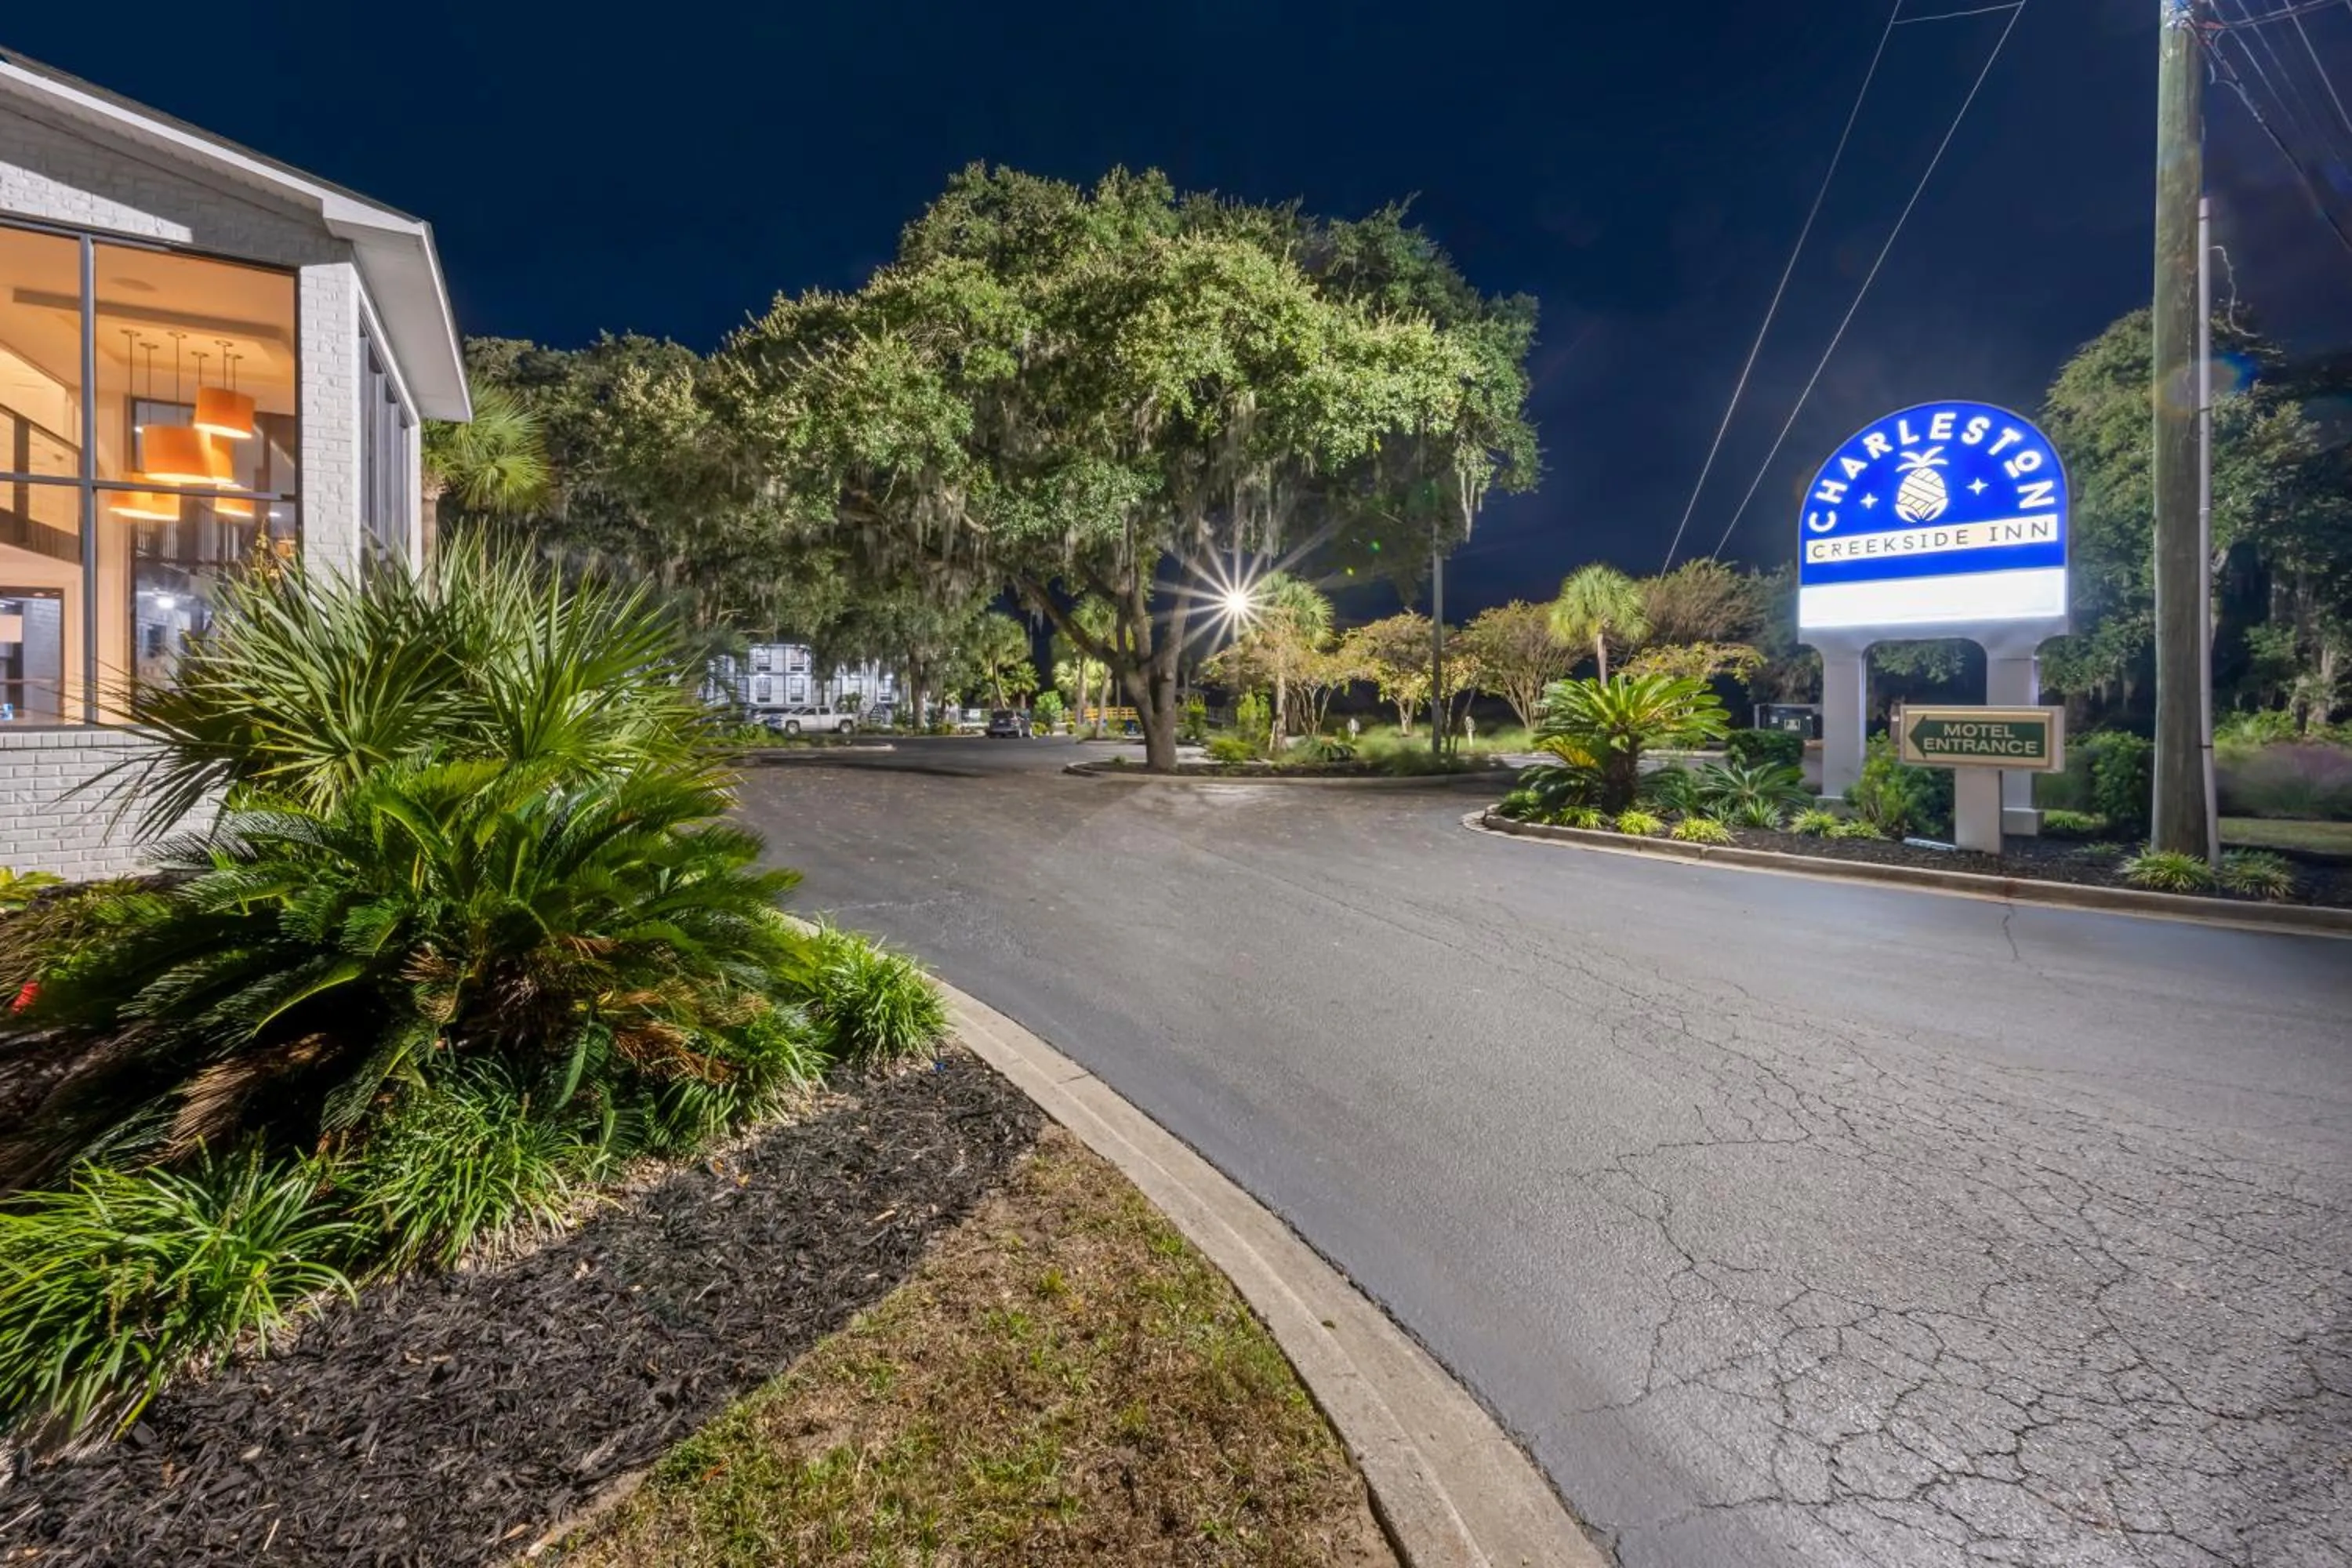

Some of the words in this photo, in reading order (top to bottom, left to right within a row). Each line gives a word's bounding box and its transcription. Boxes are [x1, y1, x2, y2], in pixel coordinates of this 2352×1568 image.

[1809, 412, 2056, 533] CHARLESTON
[1812, 529, 1969, 559] CREEKSIDE
[1989, 521, 2049, 542] INN
[1944, 724, 2016, 739] MOTEL
[1923, 737, 2038, 754] ENTRANCE
